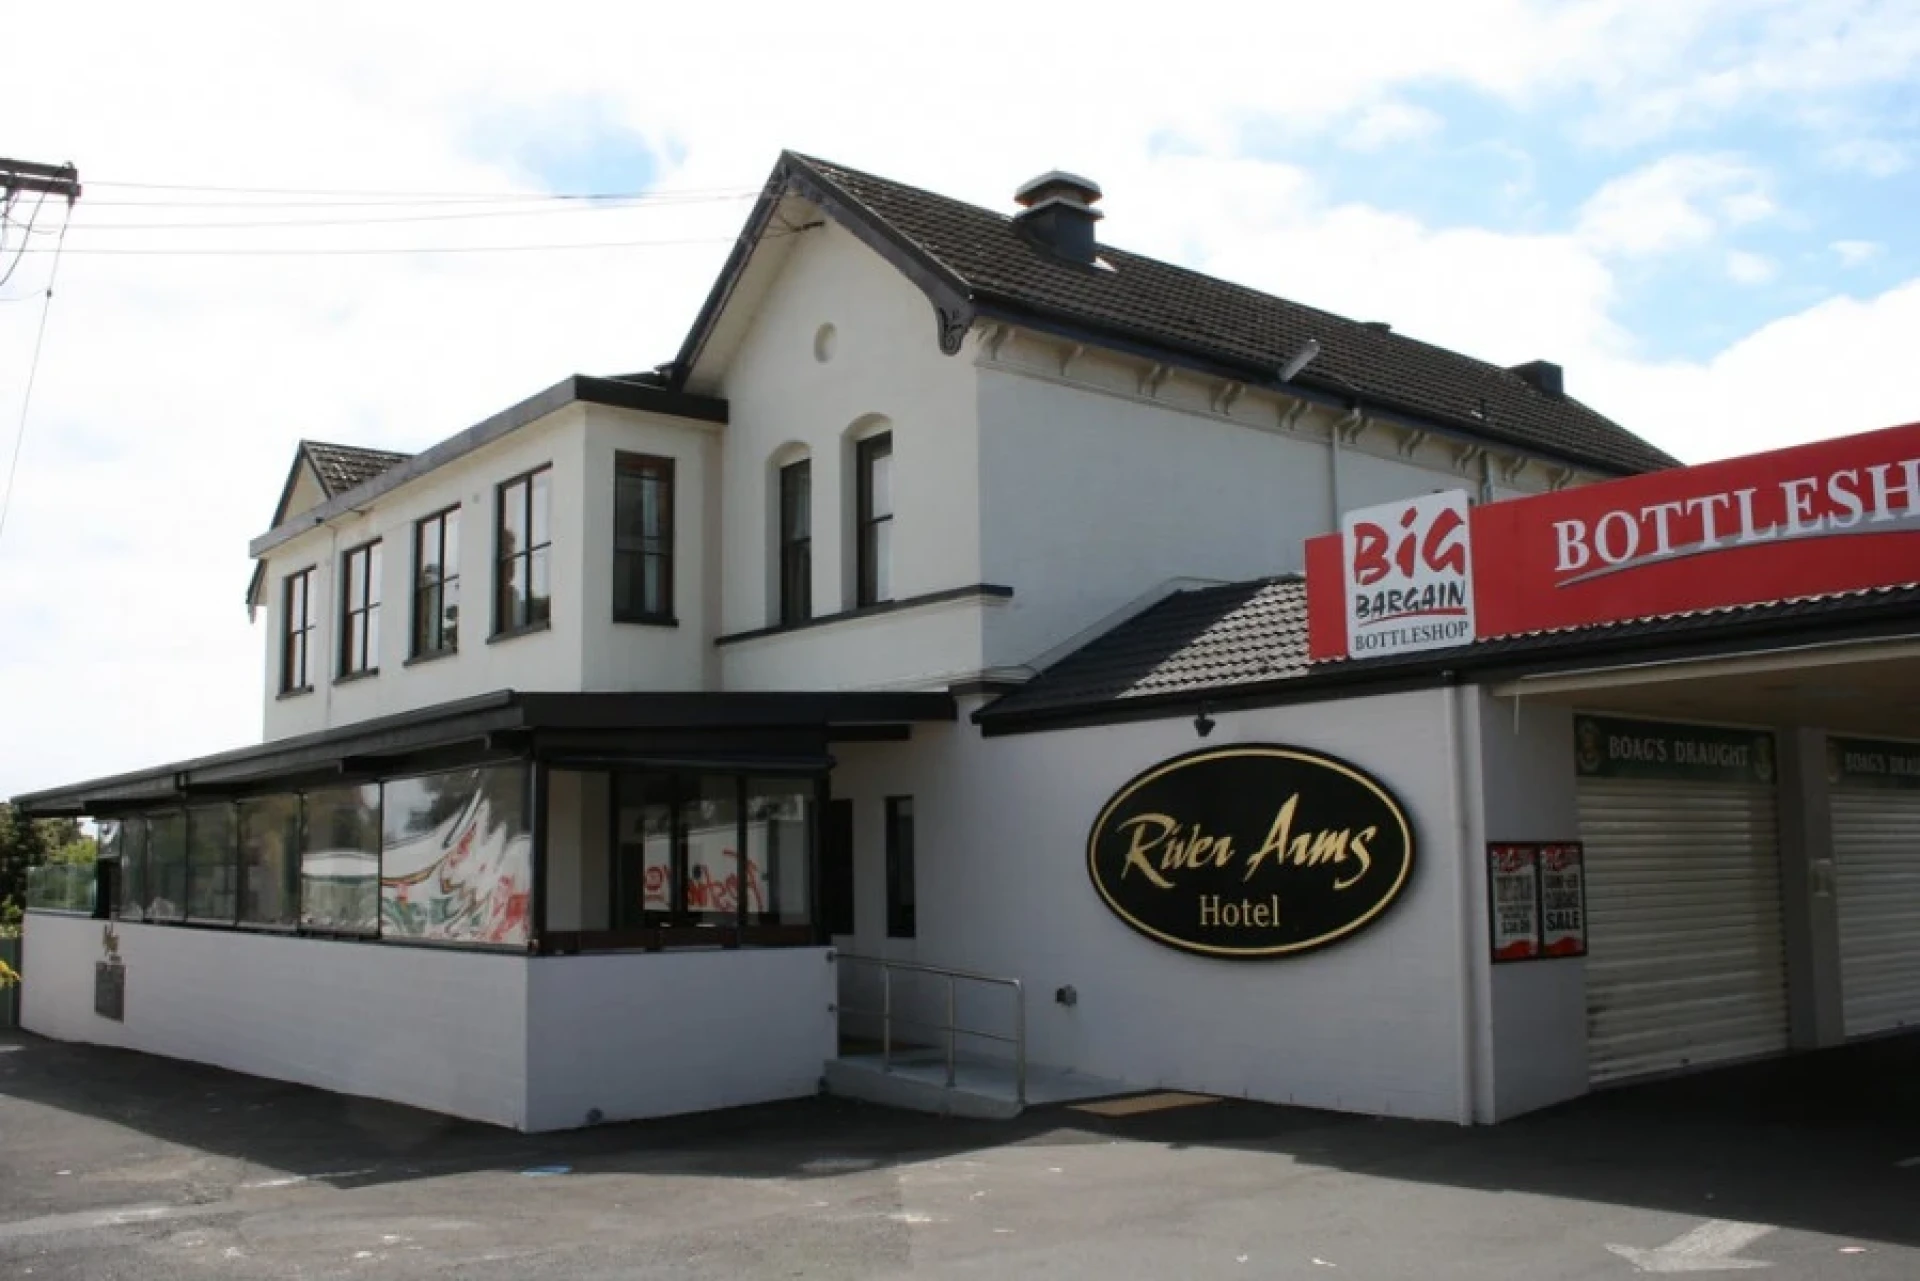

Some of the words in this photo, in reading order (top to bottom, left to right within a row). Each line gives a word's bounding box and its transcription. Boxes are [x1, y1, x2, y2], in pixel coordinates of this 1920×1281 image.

[1554, 459, 1920, 572] BOTTLESH
[1355, 580, 1466, 619] BARGAIN
[1355, 620, 1469, 651] BOTTLESHOP
[1609, 735, 1668, 763] BOAG'S
[1674, 740, 1748, 768] DRAUGHT
[1116, 813, 1237, 890] River
[1243, 792, 1377, 892] Arms
[1200, 894, 1280, 928] Hotel
[1546, 910, 1580, 932] SALE
